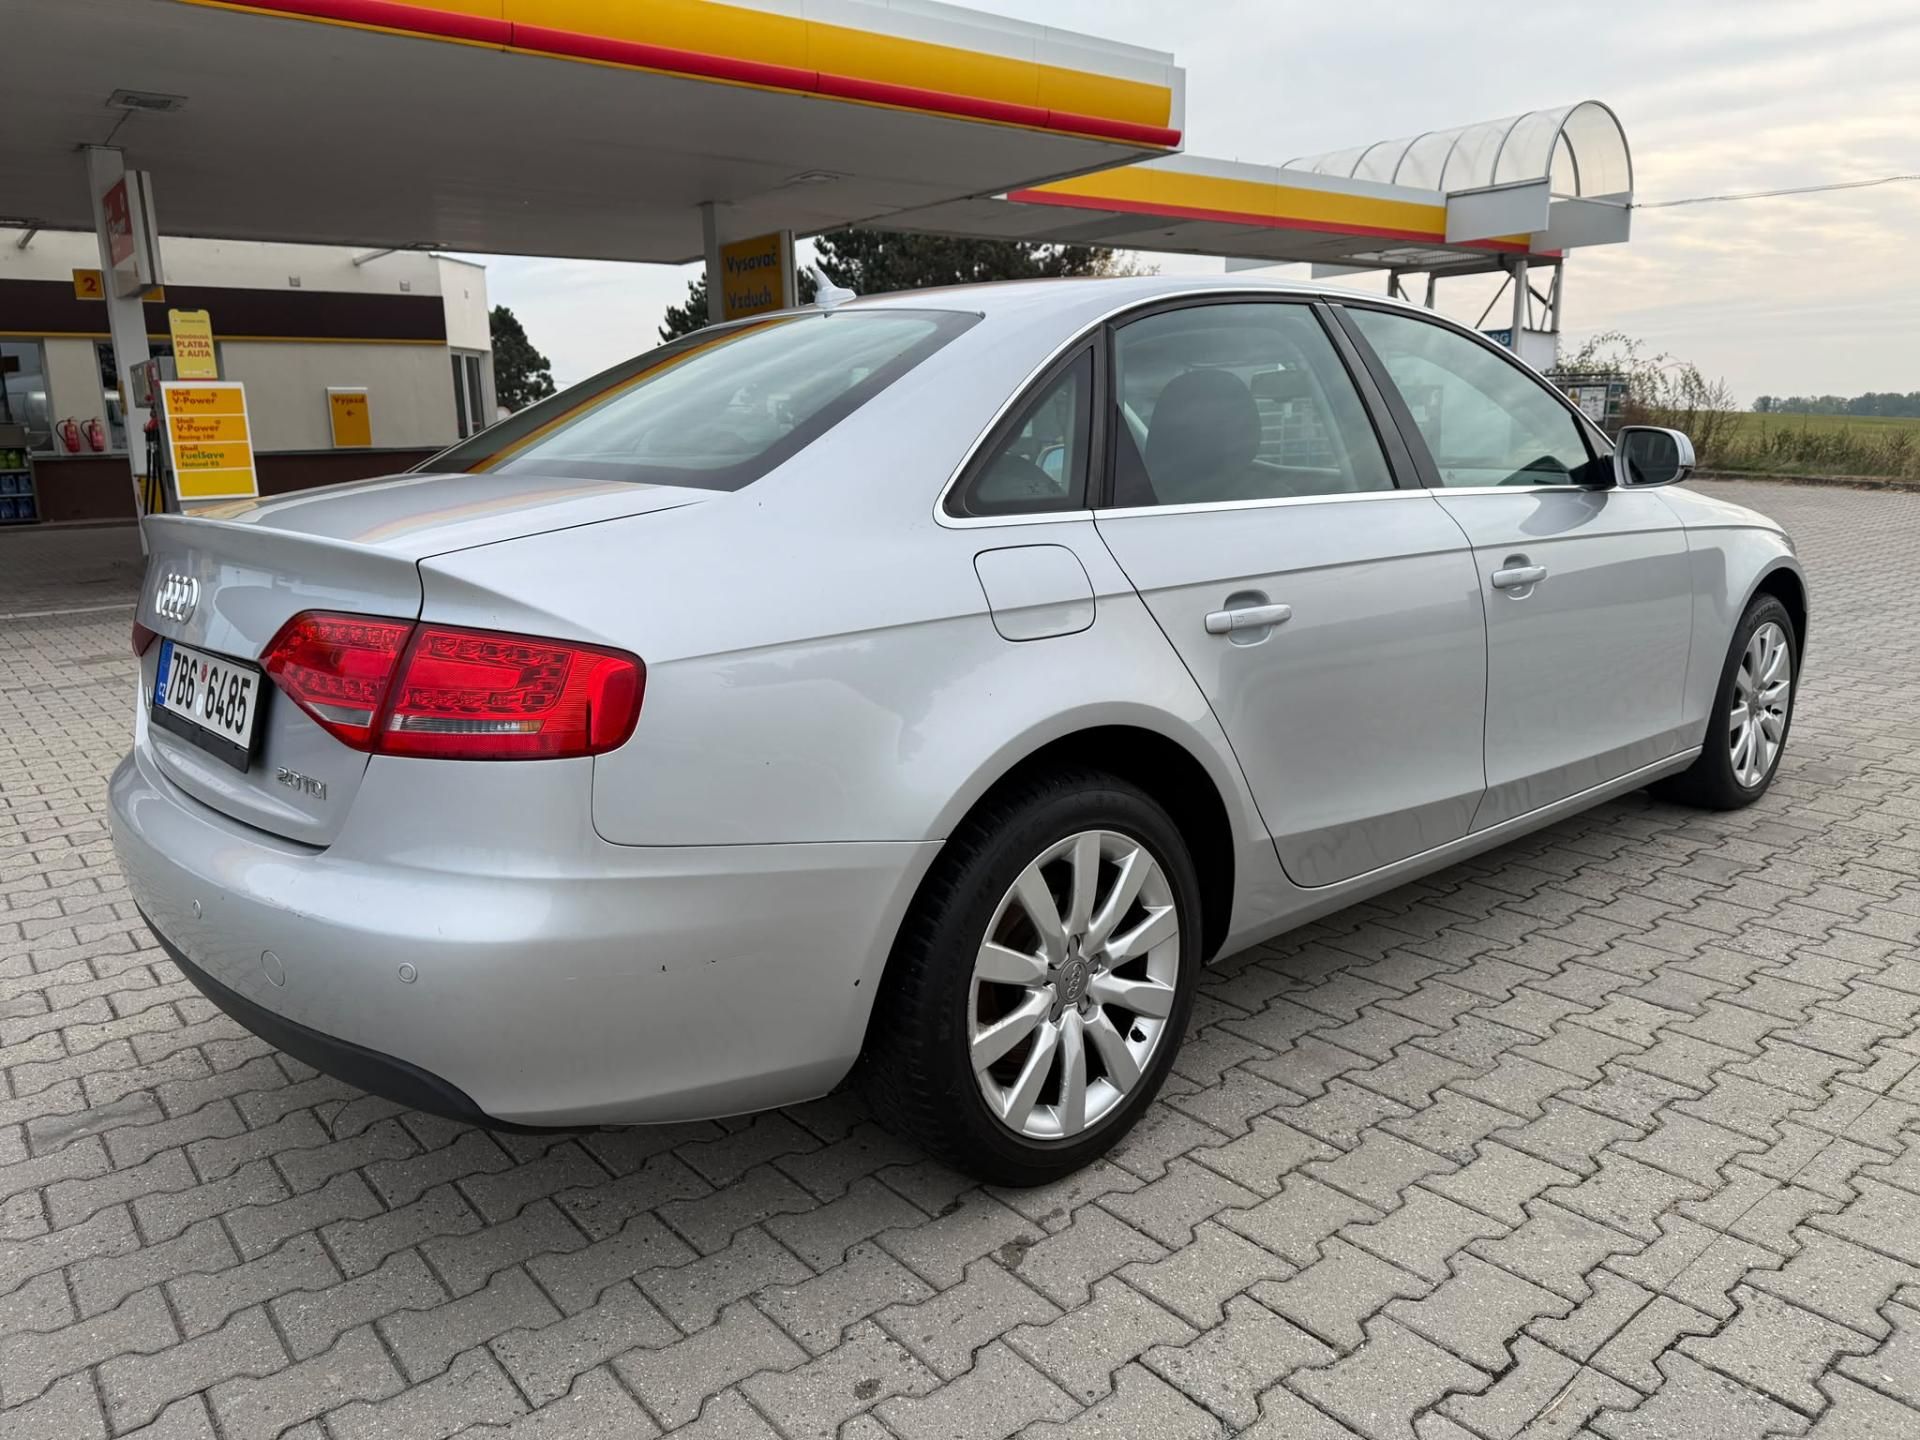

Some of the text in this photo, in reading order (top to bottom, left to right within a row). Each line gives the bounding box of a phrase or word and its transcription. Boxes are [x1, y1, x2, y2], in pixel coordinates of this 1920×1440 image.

[726, 249, 777, 277] Vysavač
[83, 277, 97, 292] 2
[728, 284, 773, 310] Vzduch
[176, 340, 210, 349] PLATBA
[178, 350, 211, 358] Z AUTA
[172, 389, 191, 397] Shell
[172, 396, 216, 405] V-Power
[176, 417, 194, 425] Shell
[176, 424, 220, 433] V-Power
[180, 444, 198, 452] Shell
[180, 450, 225, 460] FuelSave
[158, 681, 167, 697] CZ
[167, 651, 251, 735] 7B6 6485
